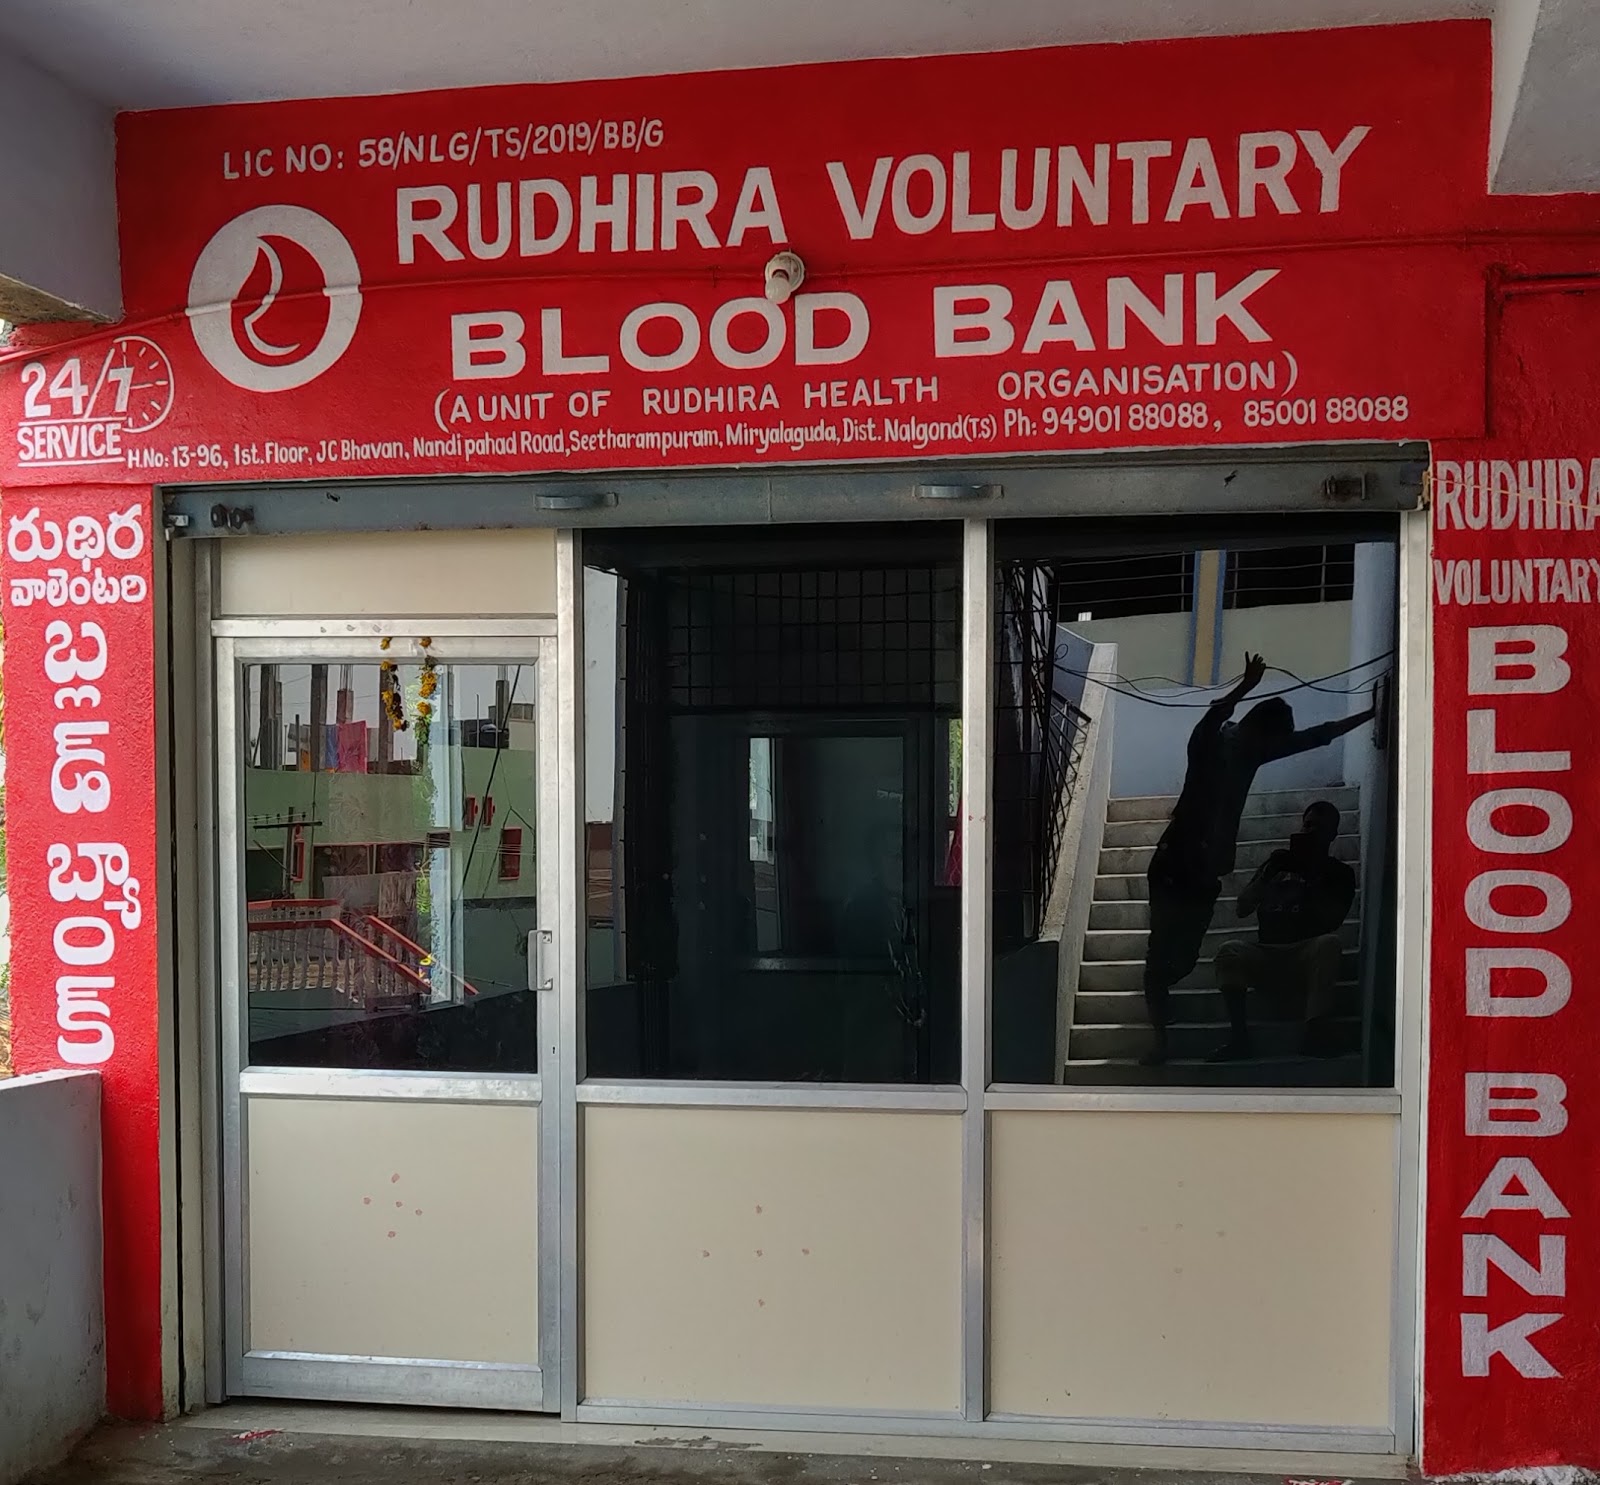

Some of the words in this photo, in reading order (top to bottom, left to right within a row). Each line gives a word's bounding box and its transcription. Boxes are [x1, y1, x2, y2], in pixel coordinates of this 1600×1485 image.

[223, 148, 274, 180] LIC
[285, 142, 344, 174] NO:
[358, 116, 664, 171] 58/NLG/TS/2019/BB/G
[396, 165, 789, 265] RUDHIRA
[825, 125, 1372, 241] VOLUNTARY
[451, 293, 870, 382] BLOOD
[933, 268, 1282, 358] BANK
[21, 346, 134, 420] 24/7
[477, 392, 554, 422] UNIT
[568, 390, 612, 418] OF
[642, 382, 780, 415] RUDHIRA
[803, 375, 938, 409] HEALTH
[997, 350, 1299, 400] ORGANISATION)
[1003, 407, 1038, 438] Ph:
[1042, 403, 1123, 436] 94901
[1243, 399, 1317, 428] 85001
[1325, 395, 1410, 424] 88088
[17, 422, 122, 462] SERVICE
[7, 503, 144, 573] రుధిర
[10, 567, 147, 608] వాలెంటరి
[1464, 624, 1573, 1018] BLOOD
[1461, 1072, 1571, 1378] BANK
